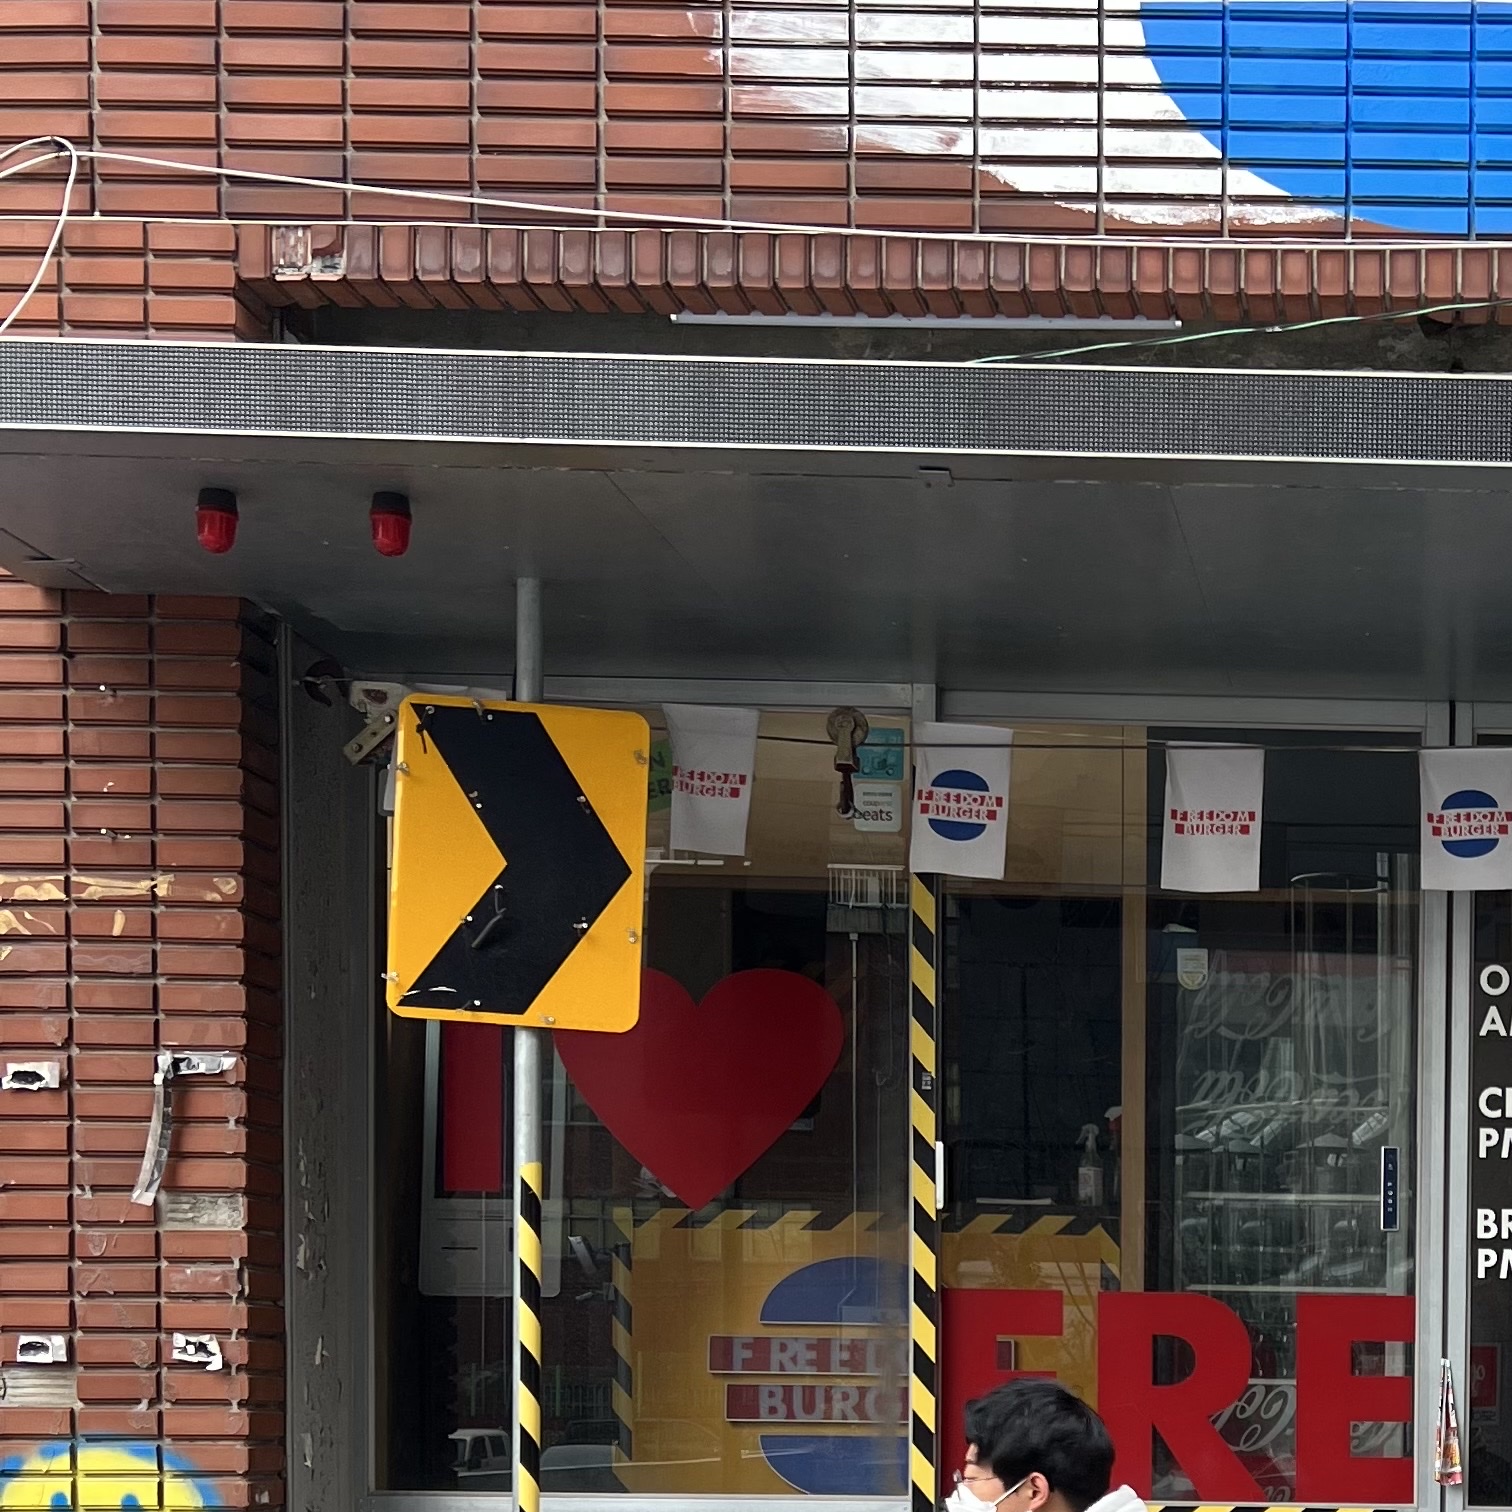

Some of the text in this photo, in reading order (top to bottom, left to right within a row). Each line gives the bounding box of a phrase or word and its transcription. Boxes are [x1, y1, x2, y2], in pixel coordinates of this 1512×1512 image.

[922, 790, 997, 807] FREEDOM
[863, 809, 893, 821] eats
[930, 804, 988, 820] BURGER
[1177, 809, 1249, 822] FREEDOM
[1433, 811, 1507, 824] FREEDOM
[1184, 823, 1241, 835] BURGER
[1441, 825, 1500, 837] BURGER
